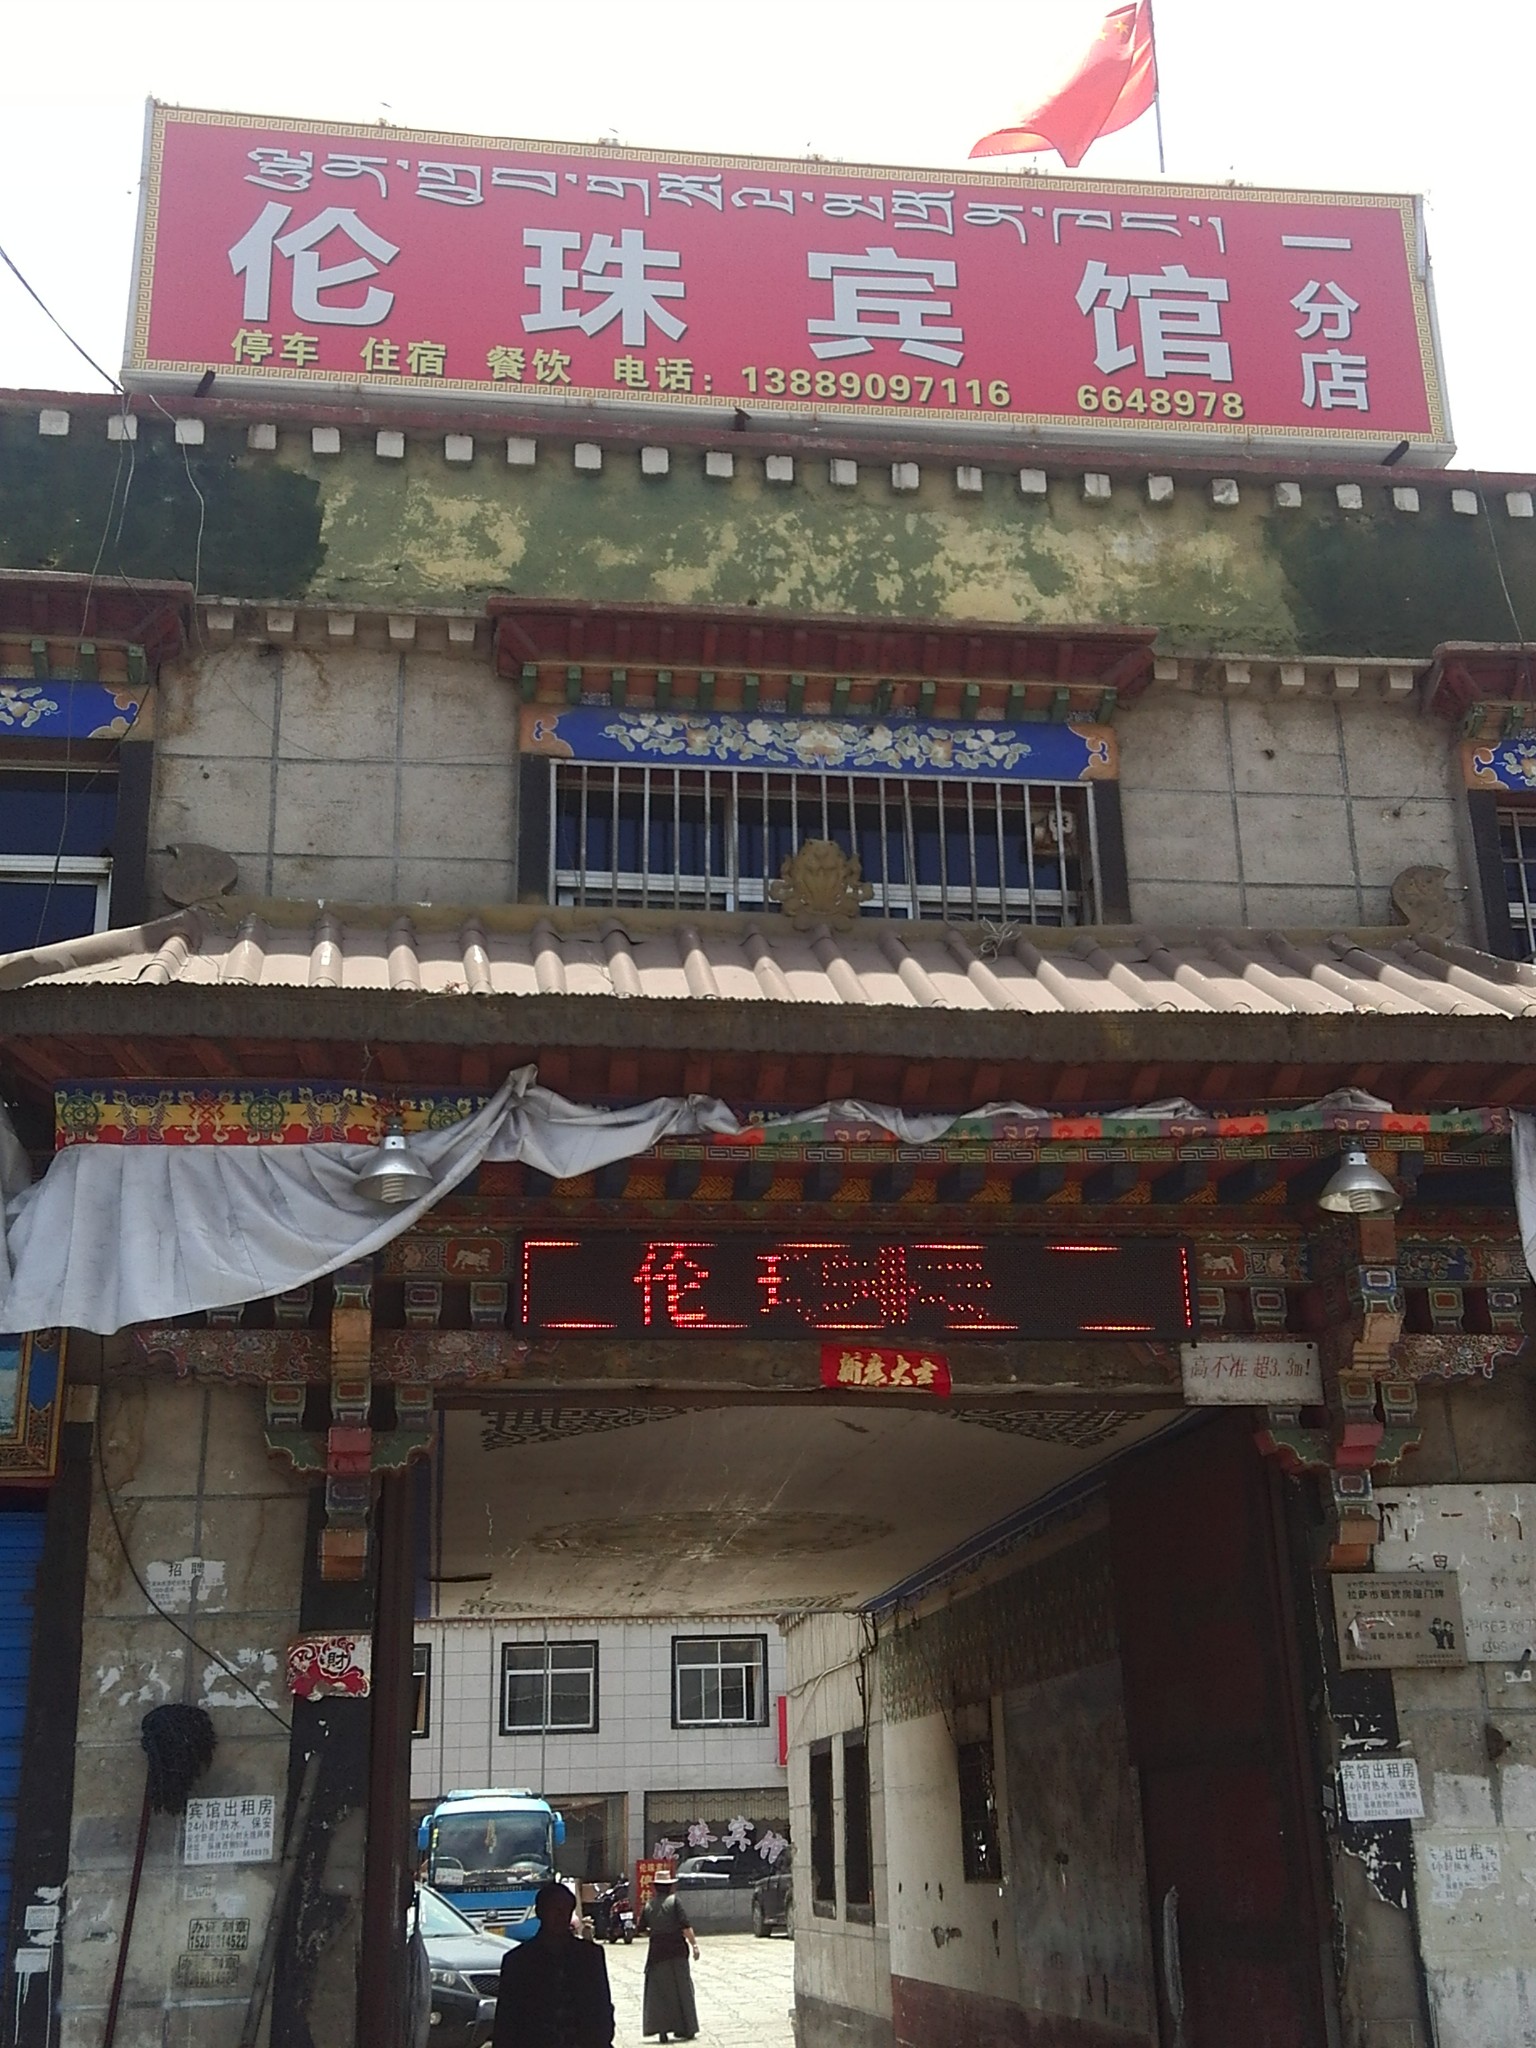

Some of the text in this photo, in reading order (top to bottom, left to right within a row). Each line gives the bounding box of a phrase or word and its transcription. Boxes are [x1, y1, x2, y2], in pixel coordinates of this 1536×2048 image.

[228, 200, 1233, 381] 伦珠宾馆
[1281, 235, 1369, 411] 一分店
[231, 328, 319, 366] 停车
[360, 336, 447, 376] 住宿
[487, 345, 571, 384] 餐饮
[741, 366, 1010, 407] 13889097116
[1076, 384, 1244, 418] 6648978
[168, 1562, 205, 1577] 招聘
[327, 1651, 348, 1670] 財
[1342, 1762, 1416, 1780] 宾馆出租房
[188, 1798, 273, 1819] 宾馆出租房
